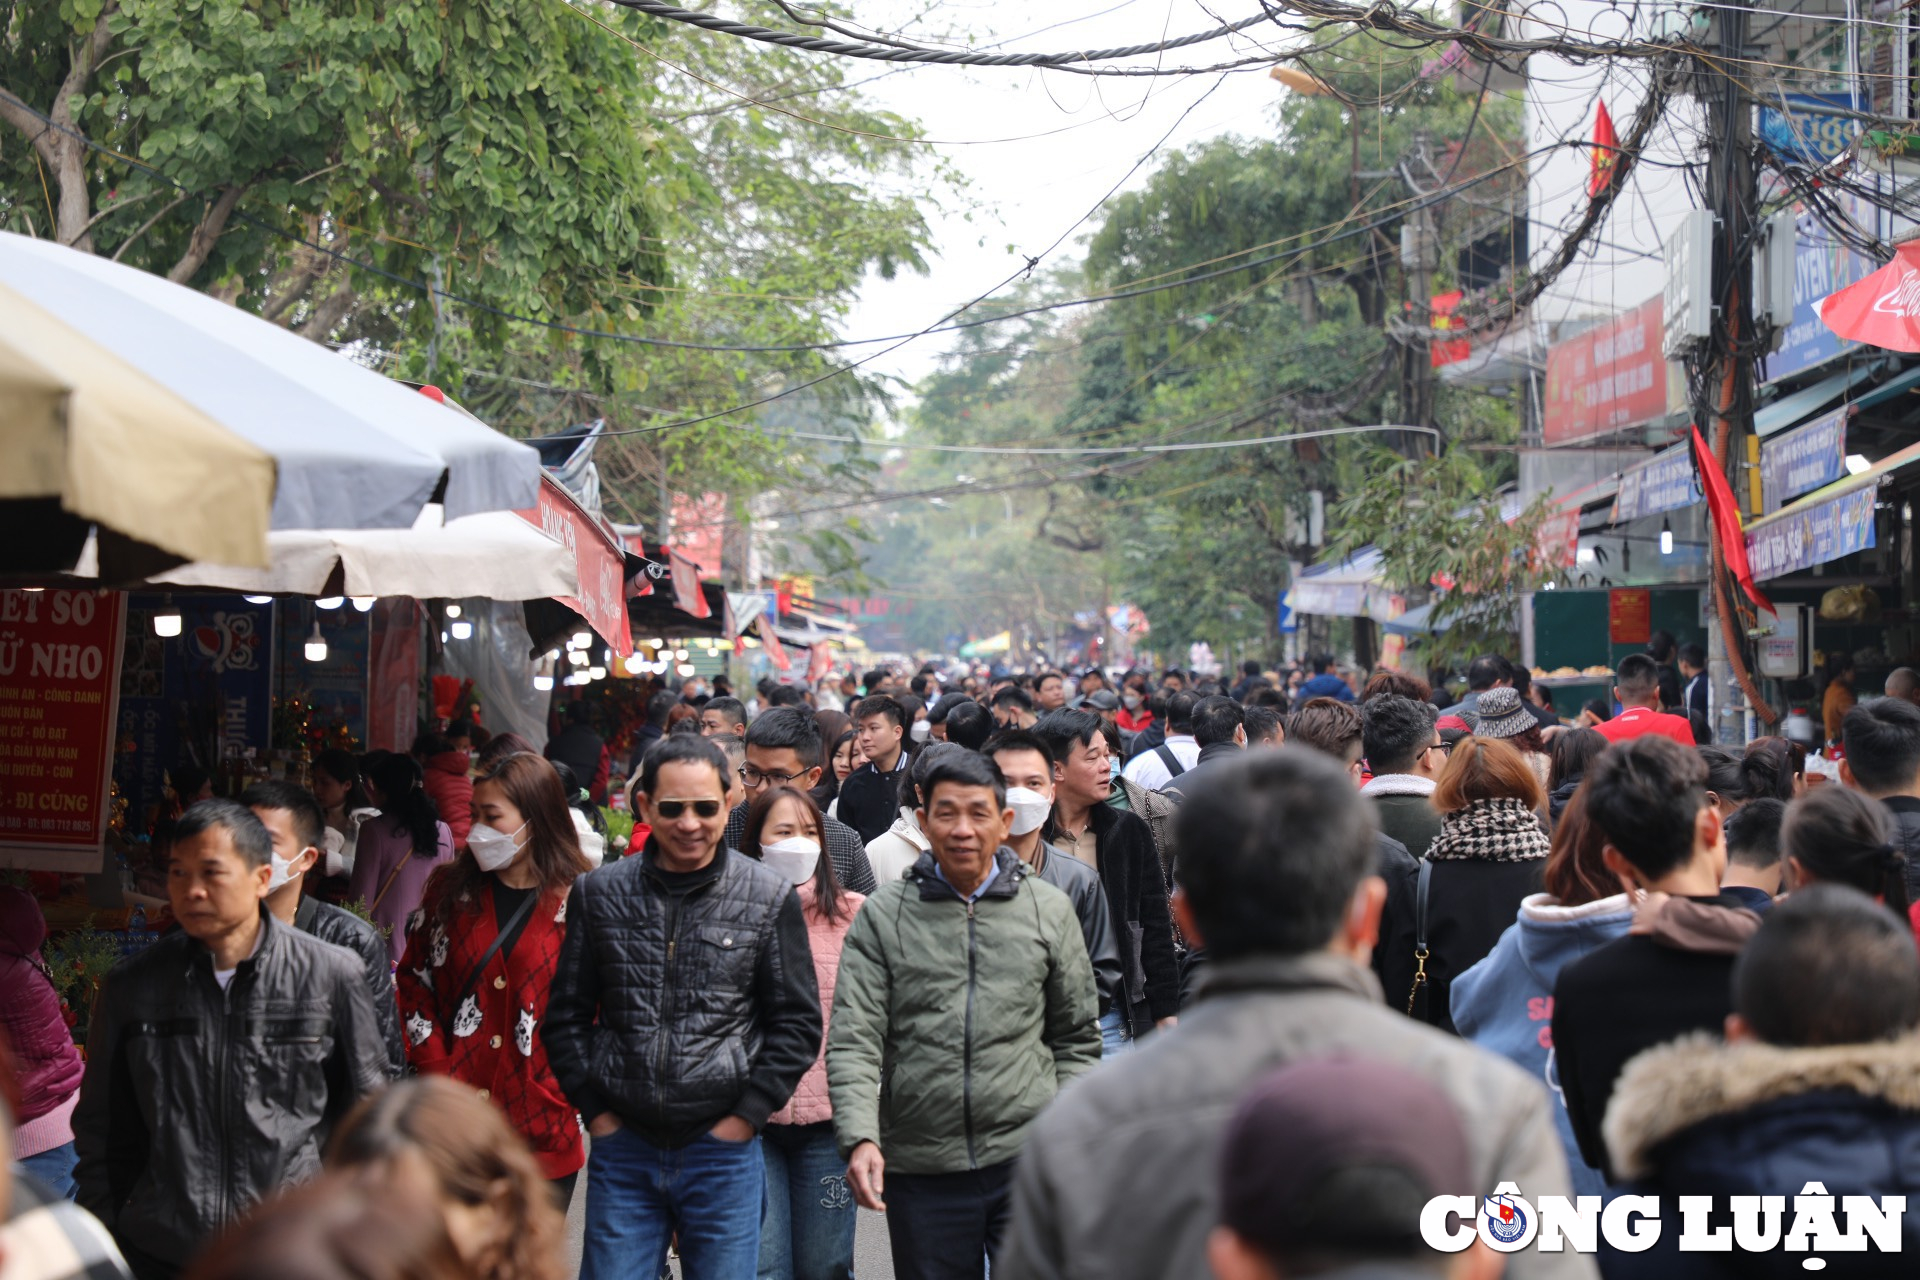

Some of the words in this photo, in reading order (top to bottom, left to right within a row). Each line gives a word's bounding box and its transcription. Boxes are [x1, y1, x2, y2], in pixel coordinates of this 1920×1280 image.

[1789, 112, 1856, 156] Tige
[30, 641, 103, 680] NHO
[21, 687, 36, 700] AN
[44, 686, 72, 702] CÔNG
[73, 690, 102, 704] DANH
[53, 765, 73, 778] CON
[15, 791, 35, 809] ĐI
[38, 788, 88, 812] CÚNG
